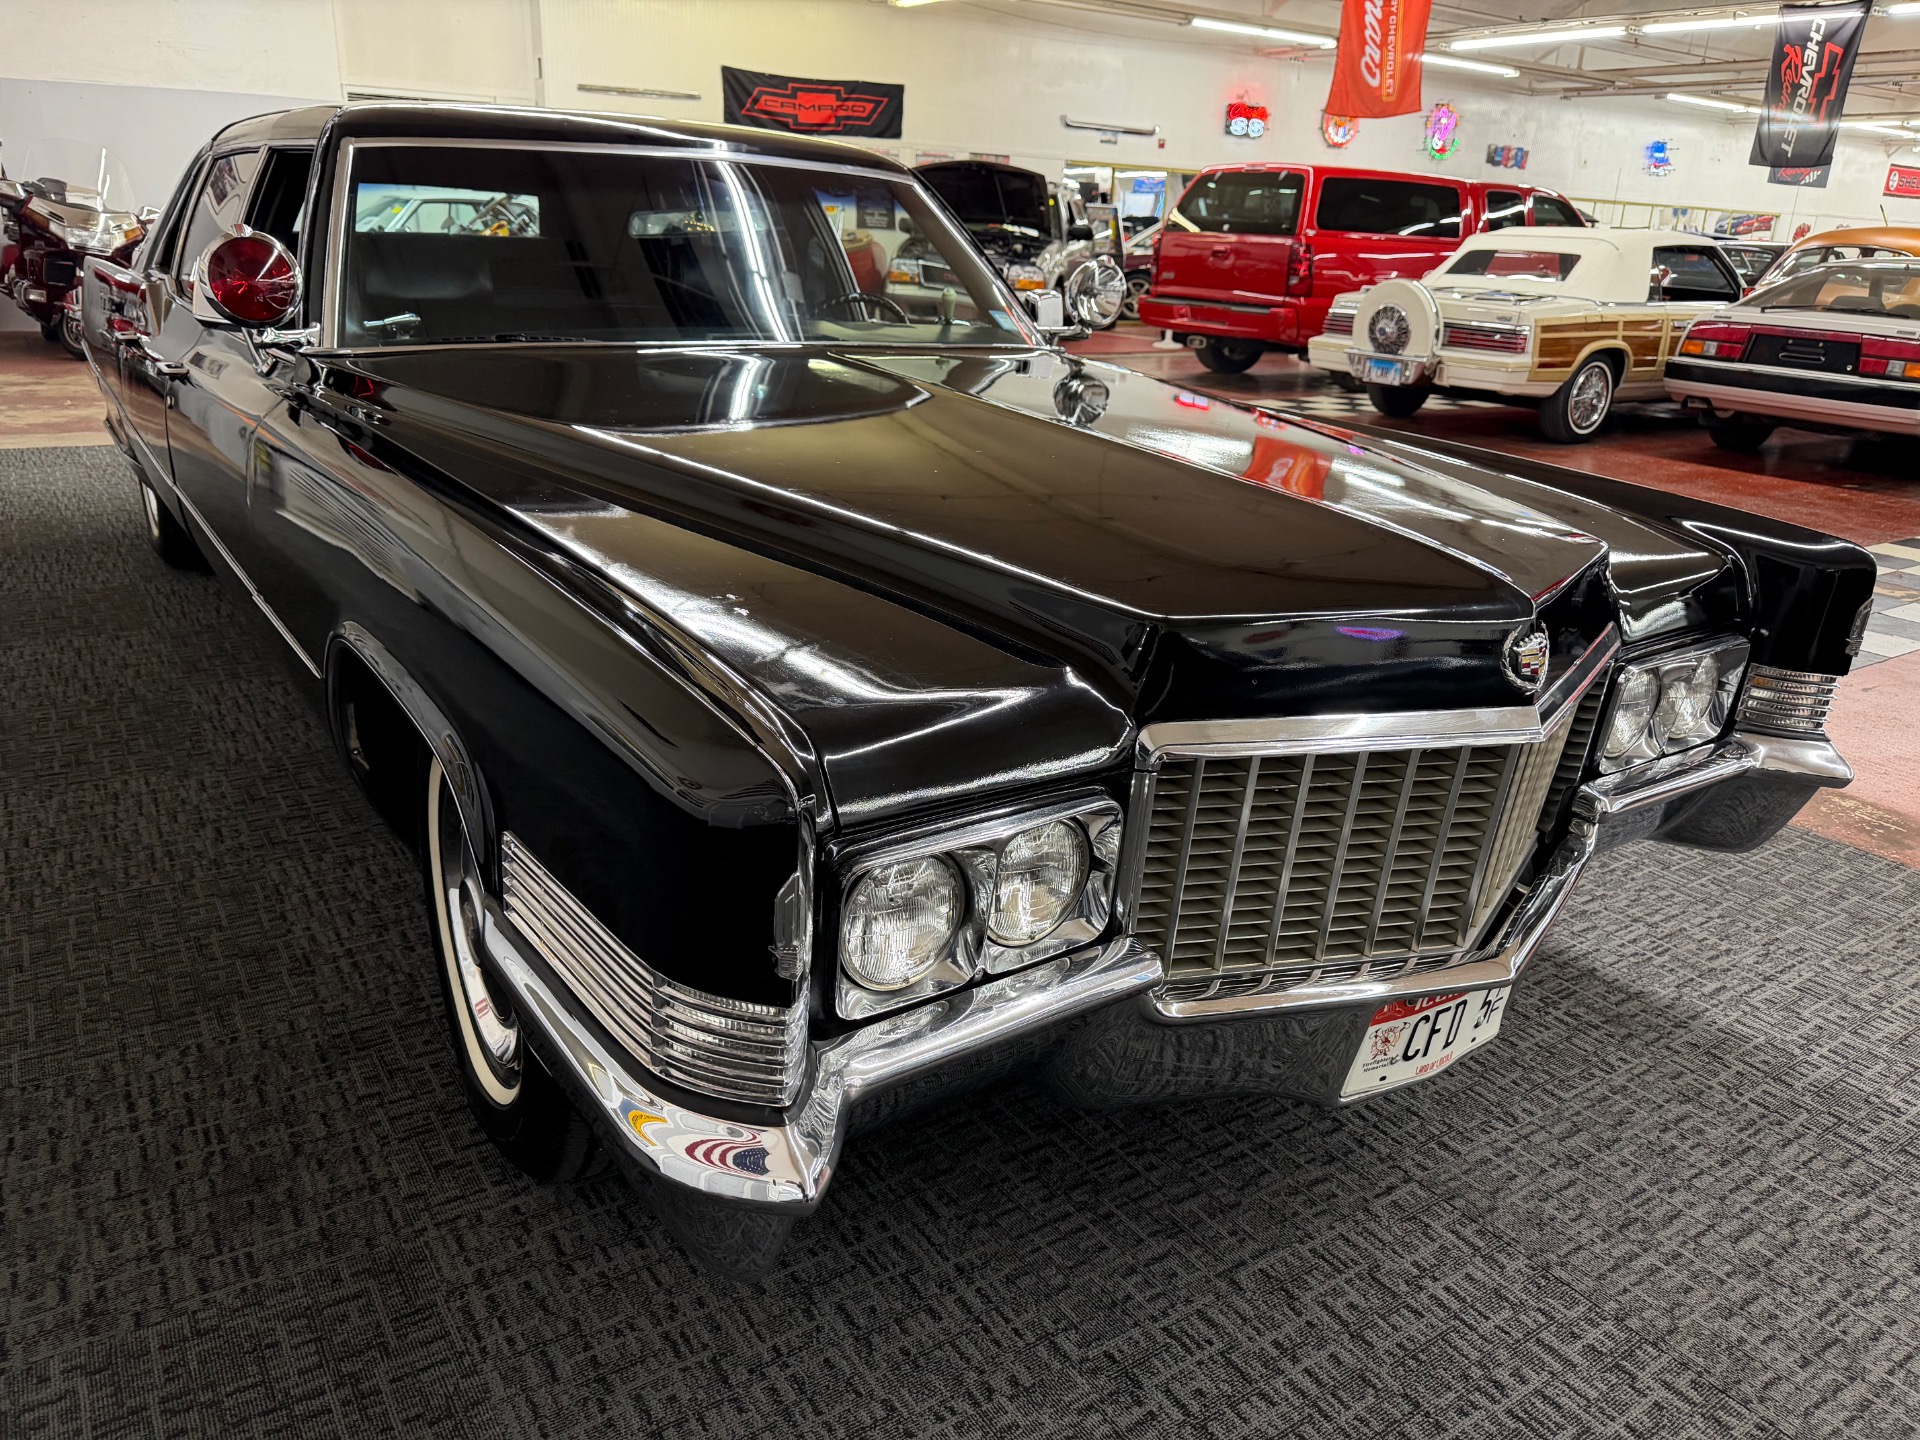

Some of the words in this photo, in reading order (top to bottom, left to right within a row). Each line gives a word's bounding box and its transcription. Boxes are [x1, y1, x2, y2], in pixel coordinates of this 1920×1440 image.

[1386, 15, 1397, 95] CHEVROLET
[1780, 17, 1827, 158] CHEVROLET
[763, 98, 867, 115] CAMARO
[1402, 998, 1469, 1061] CFD
